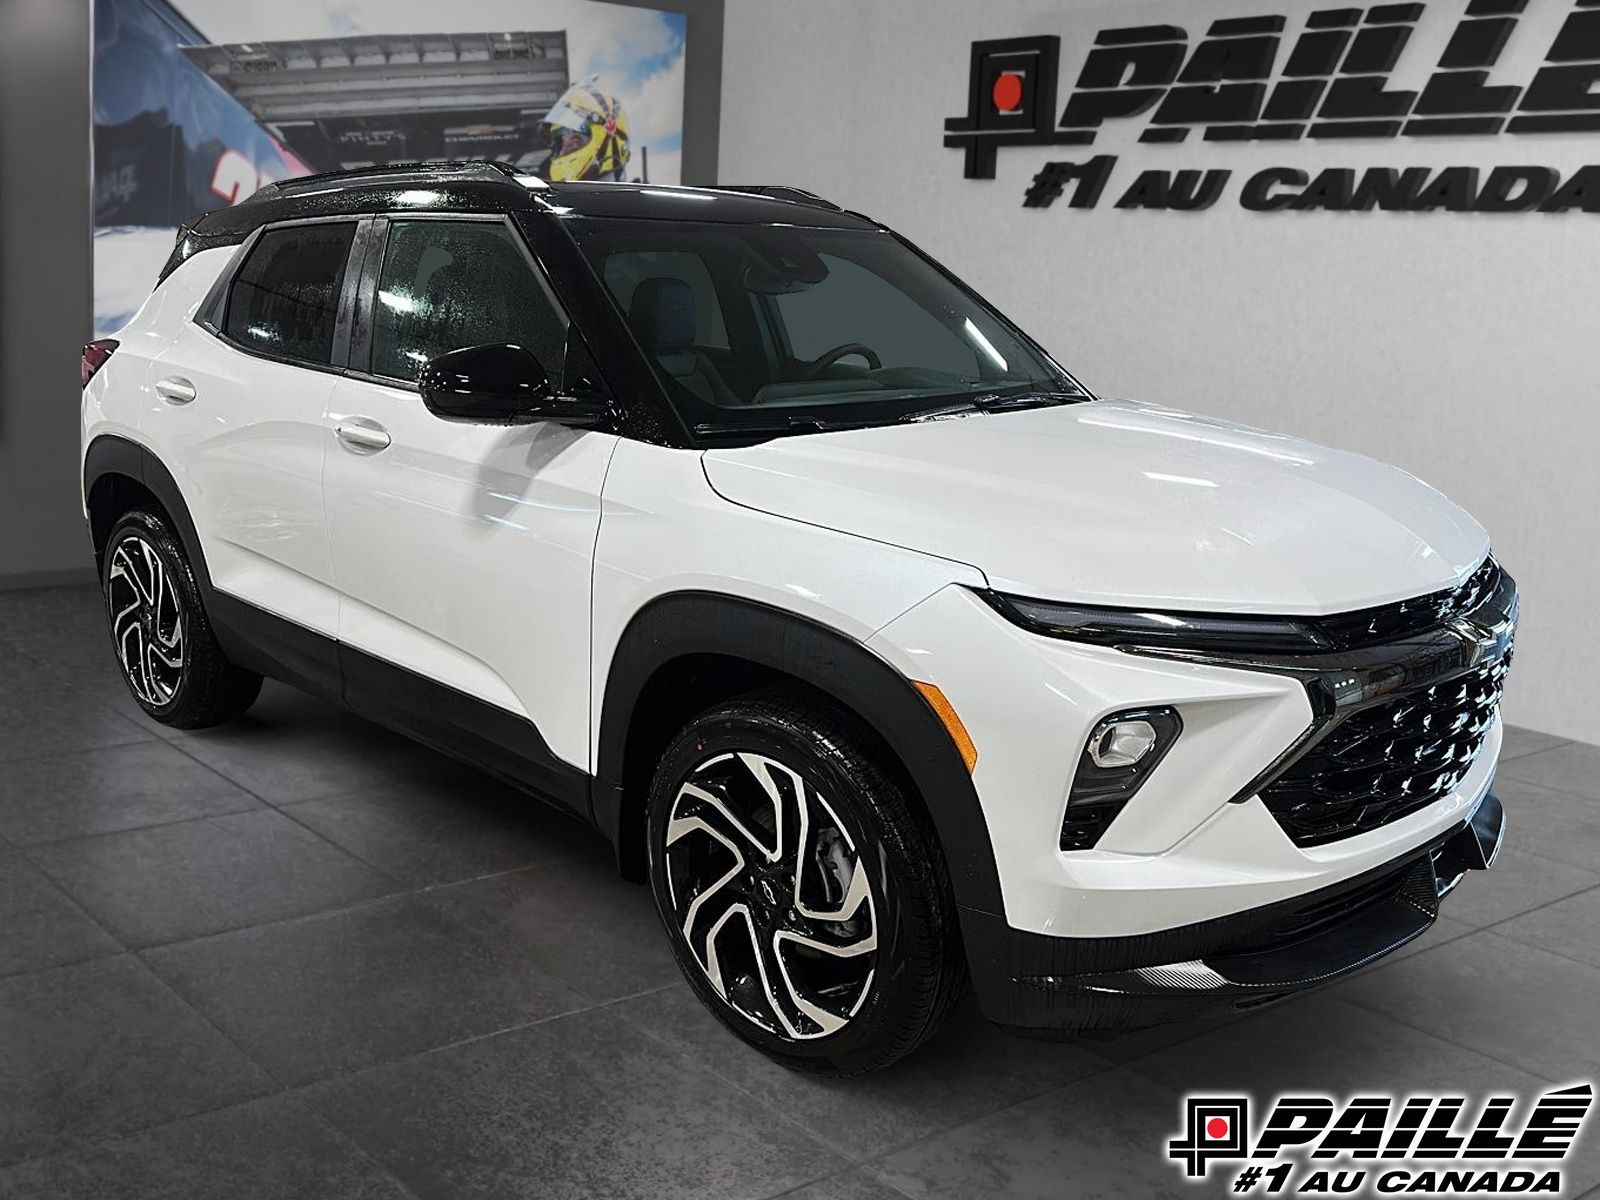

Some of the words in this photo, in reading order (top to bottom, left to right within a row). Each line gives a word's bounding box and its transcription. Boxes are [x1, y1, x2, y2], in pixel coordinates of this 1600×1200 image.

[1022, 155, 1118, 209] #1
[1113, 169, 1231, 211] AU
[1239, 165, 1600, 213] CANADA
